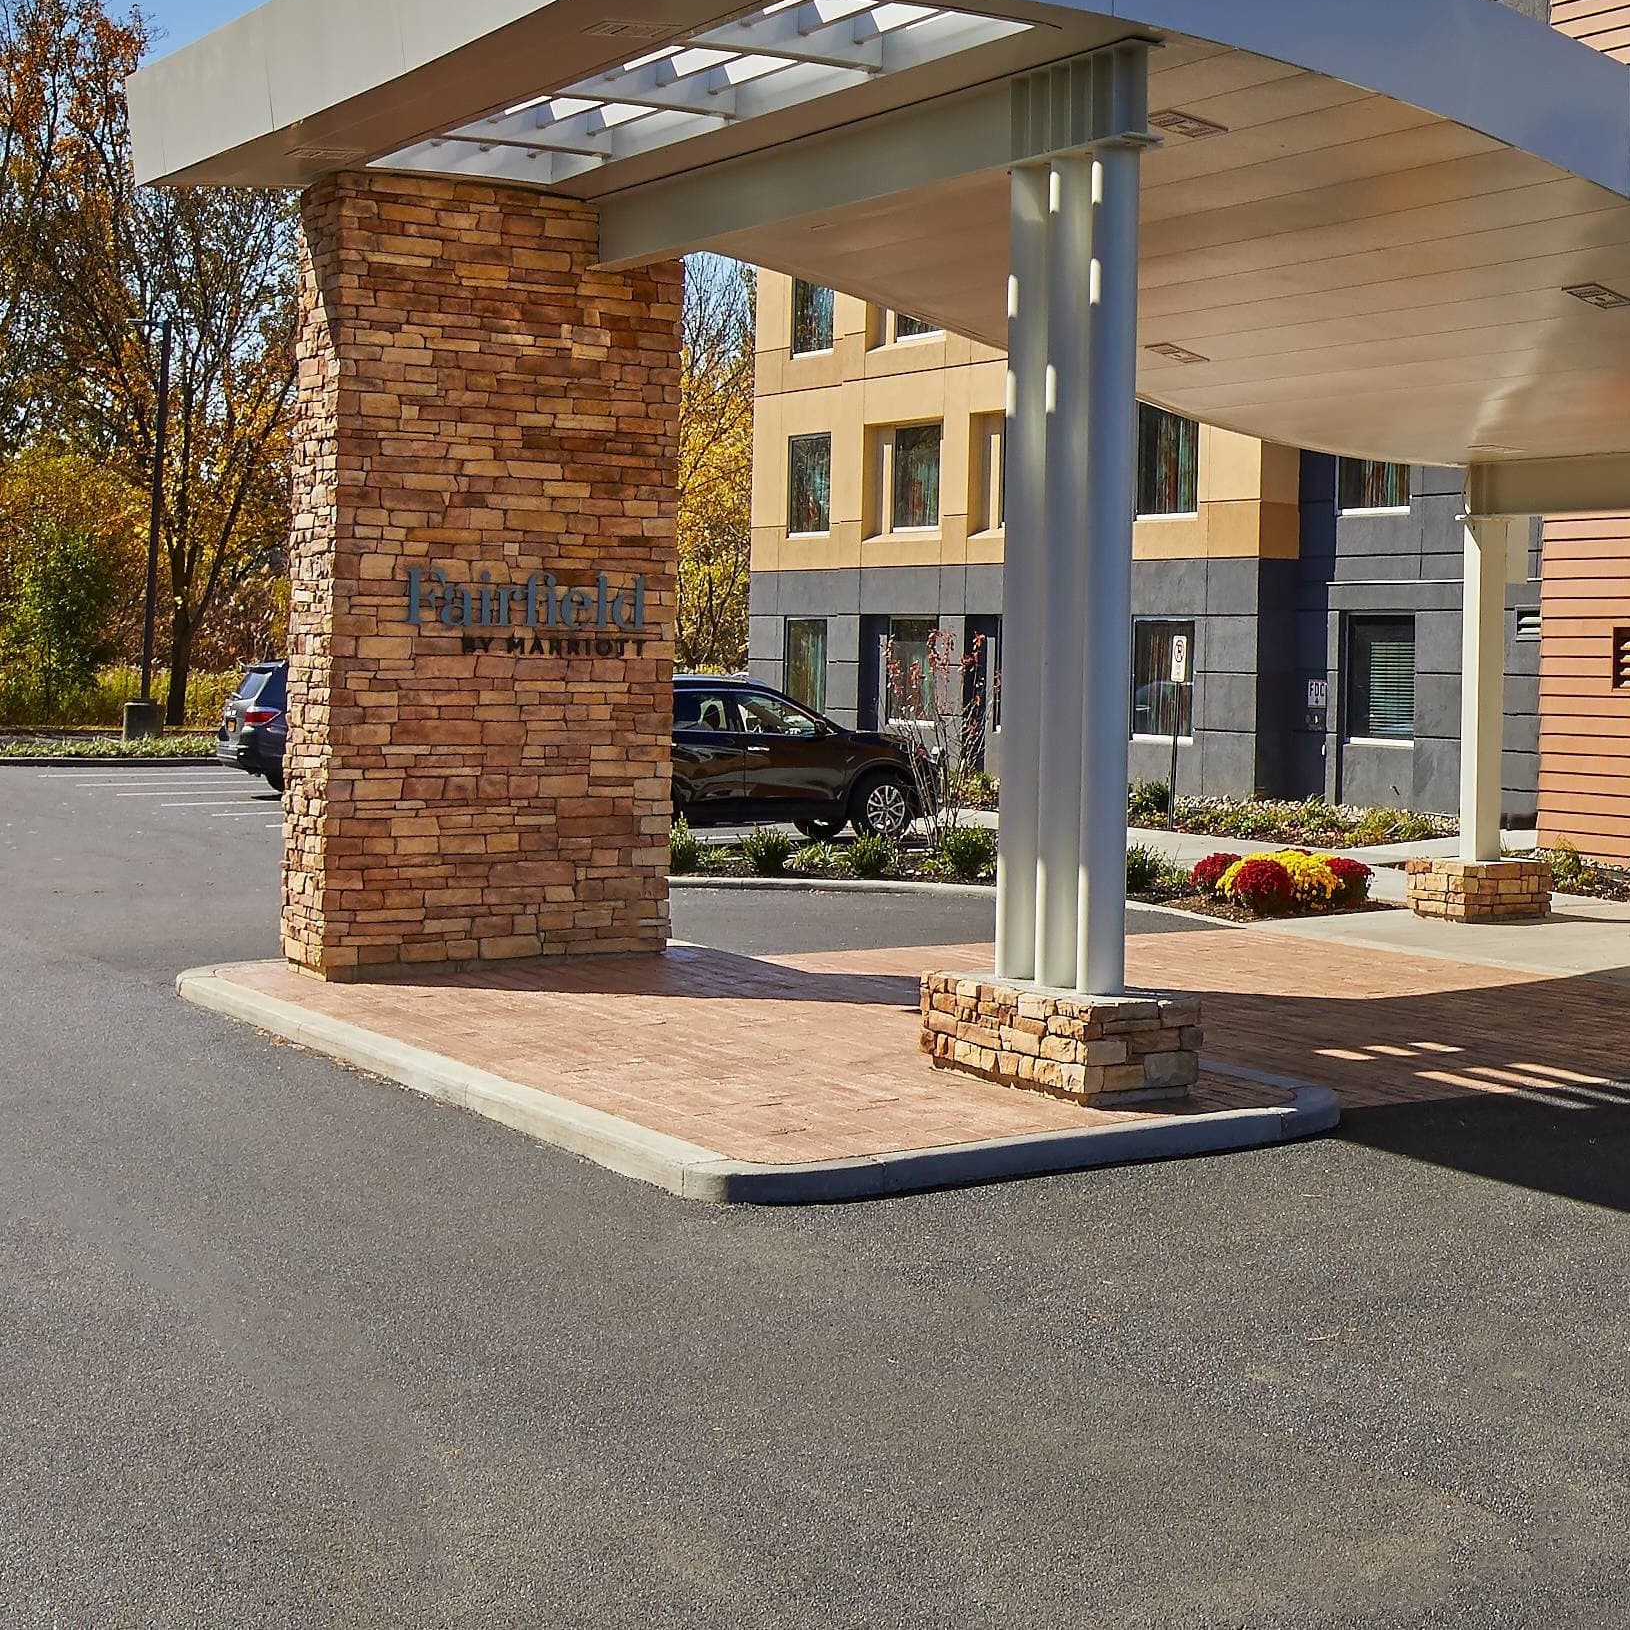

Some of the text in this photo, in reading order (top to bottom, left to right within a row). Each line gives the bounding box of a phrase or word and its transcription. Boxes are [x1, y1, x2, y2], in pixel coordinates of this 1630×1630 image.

[406, 566, 646, 632] Fairfield
[461, 635, 647, 657] BY MARRIOTT
[1309, 682, 1325, 697] FDC
